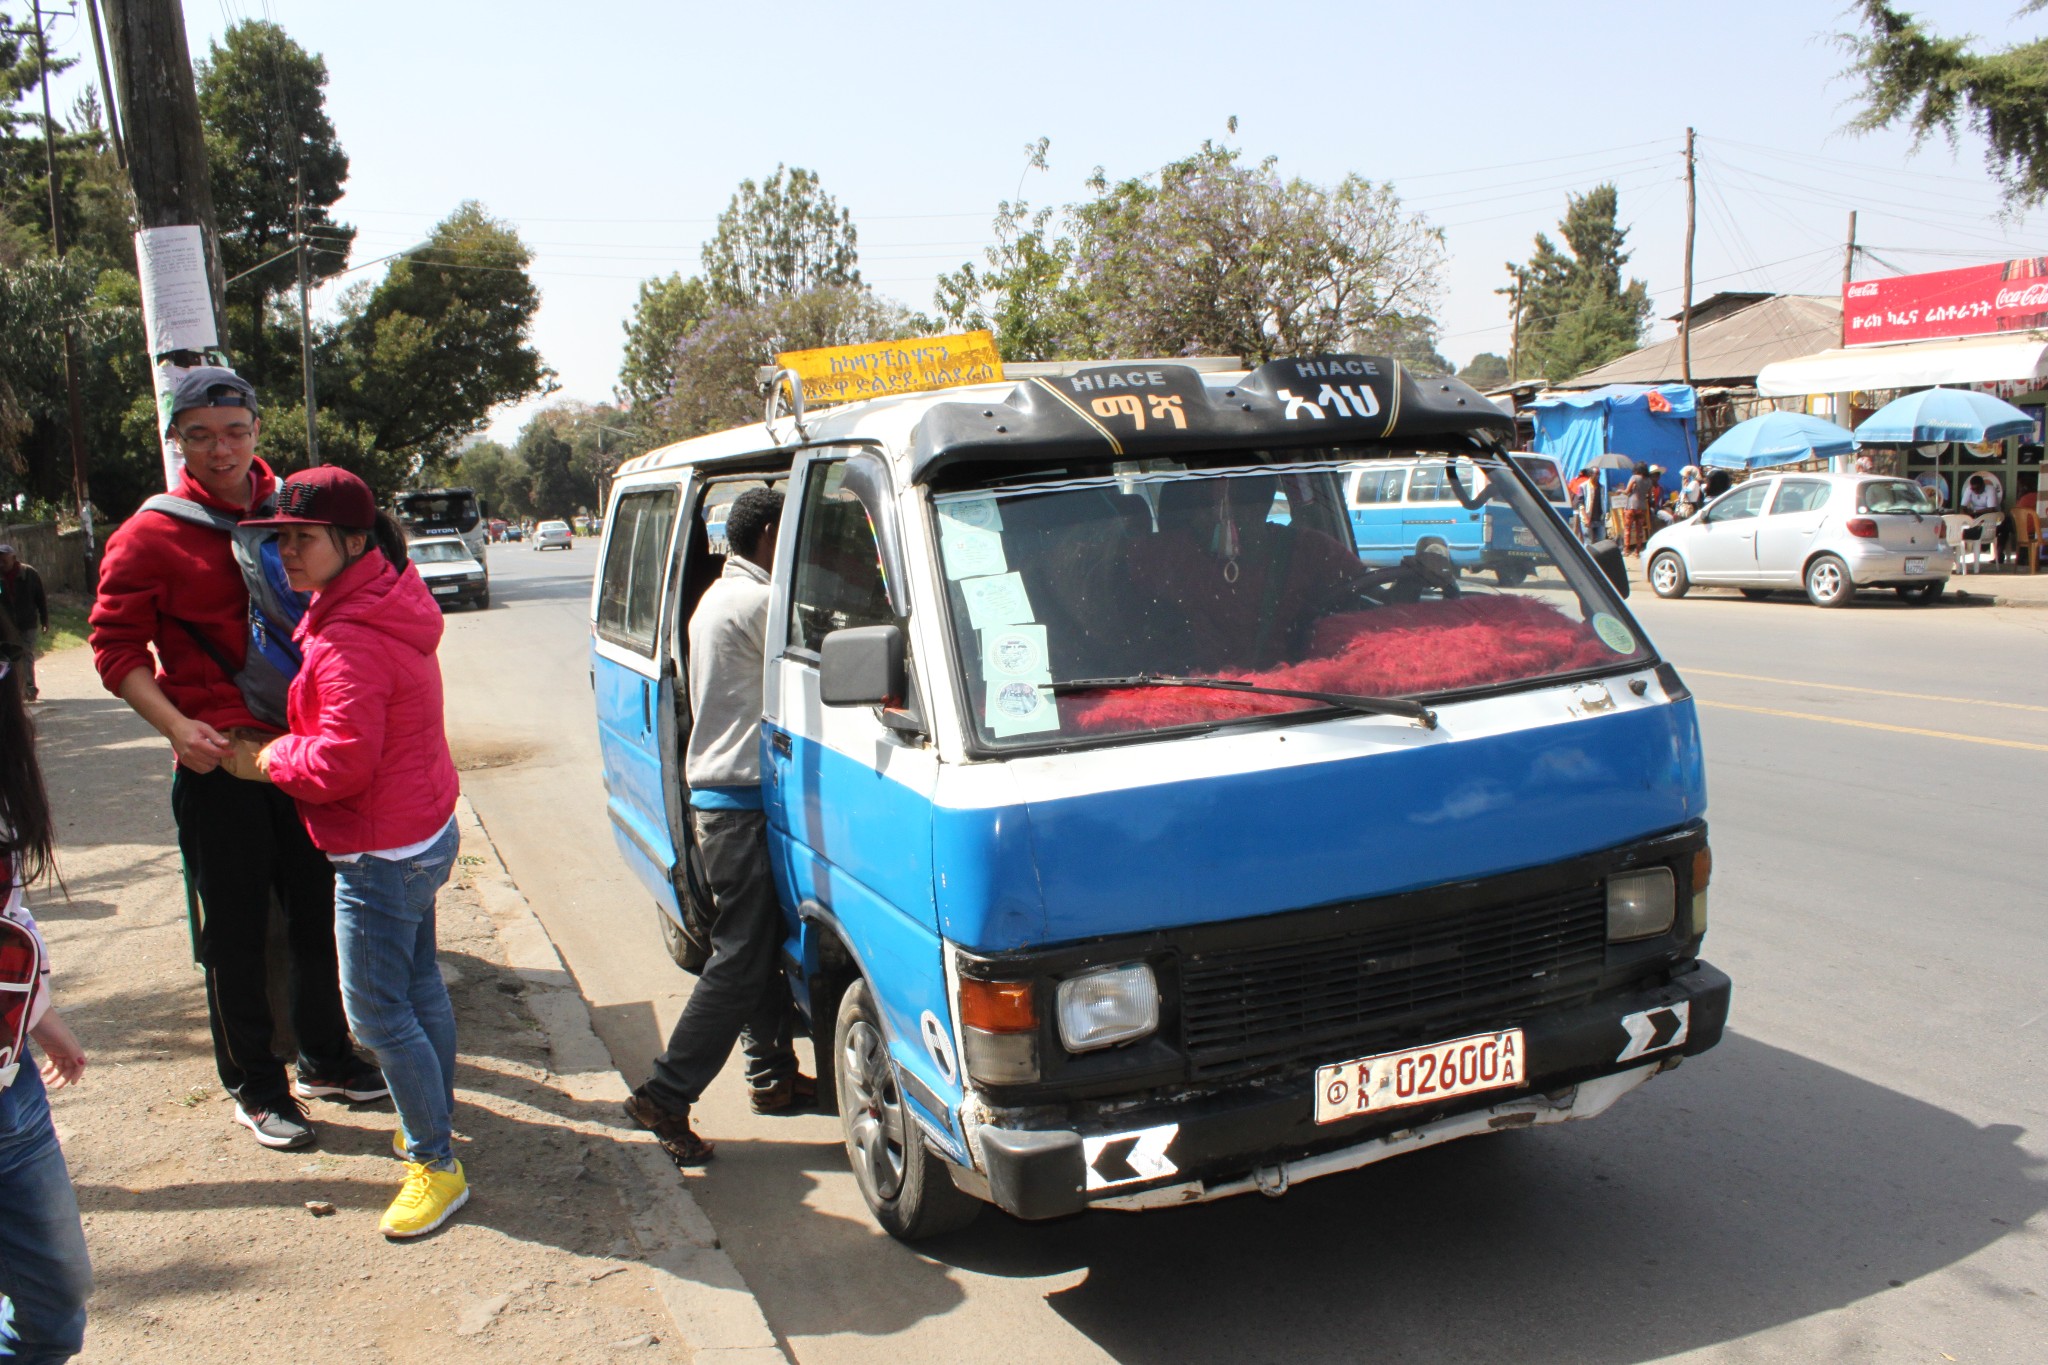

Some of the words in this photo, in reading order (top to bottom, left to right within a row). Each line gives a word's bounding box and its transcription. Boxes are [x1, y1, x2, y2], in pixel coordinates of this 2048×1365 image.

[1848, 283, 1879, 298] Coca-Cola
[1996, 283, 2048, 310] Coca-Cola
[1925, 300, 1992, 322] ሬስቶራንት
[1296, 360, 1380, 378] HIACE
[1070, 371, 1166, 392] HIACE
[1091, 393, 1187, 430] ማሻ
[1277, 383, 1380, 420] አላህ
[426, 527, 455, 535] FOTON
[1396, 1042, 1498, 1098] 02600
